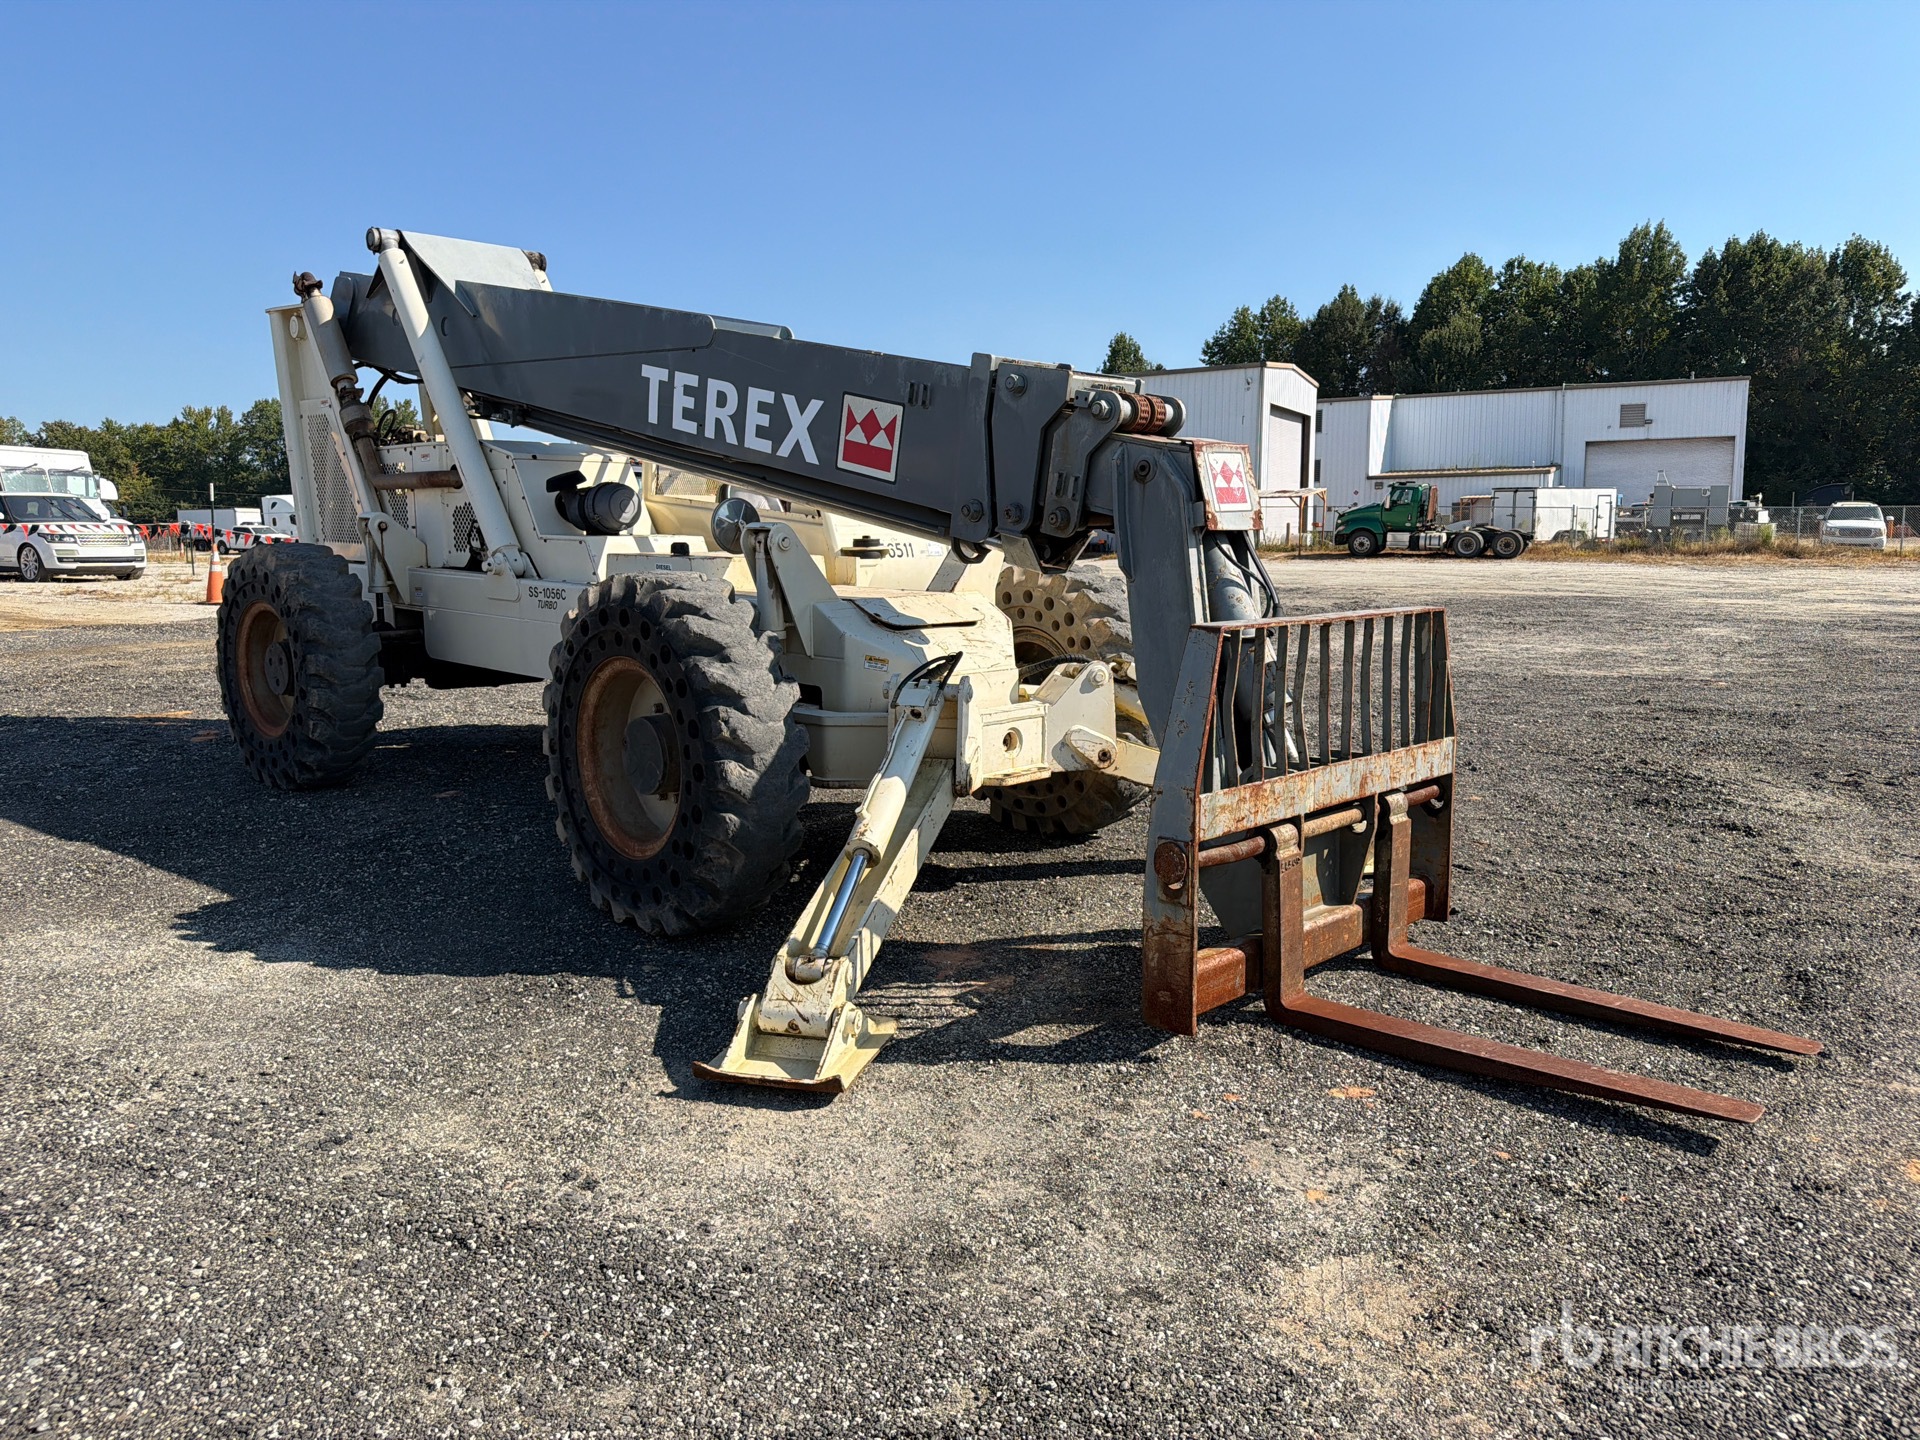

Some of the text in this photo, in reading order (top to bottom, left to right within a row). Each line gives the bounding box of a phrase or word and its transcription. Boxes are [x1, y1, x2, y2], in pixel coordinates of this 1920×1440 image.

[641, 364, 825, 465] TEREX
[880, 542, 915, 558] 6511
[655, 563, 672, 571] DIESEL
[528, 586, 567, 601] SS-1056C
[537, 600, 558, 610] TURBO
